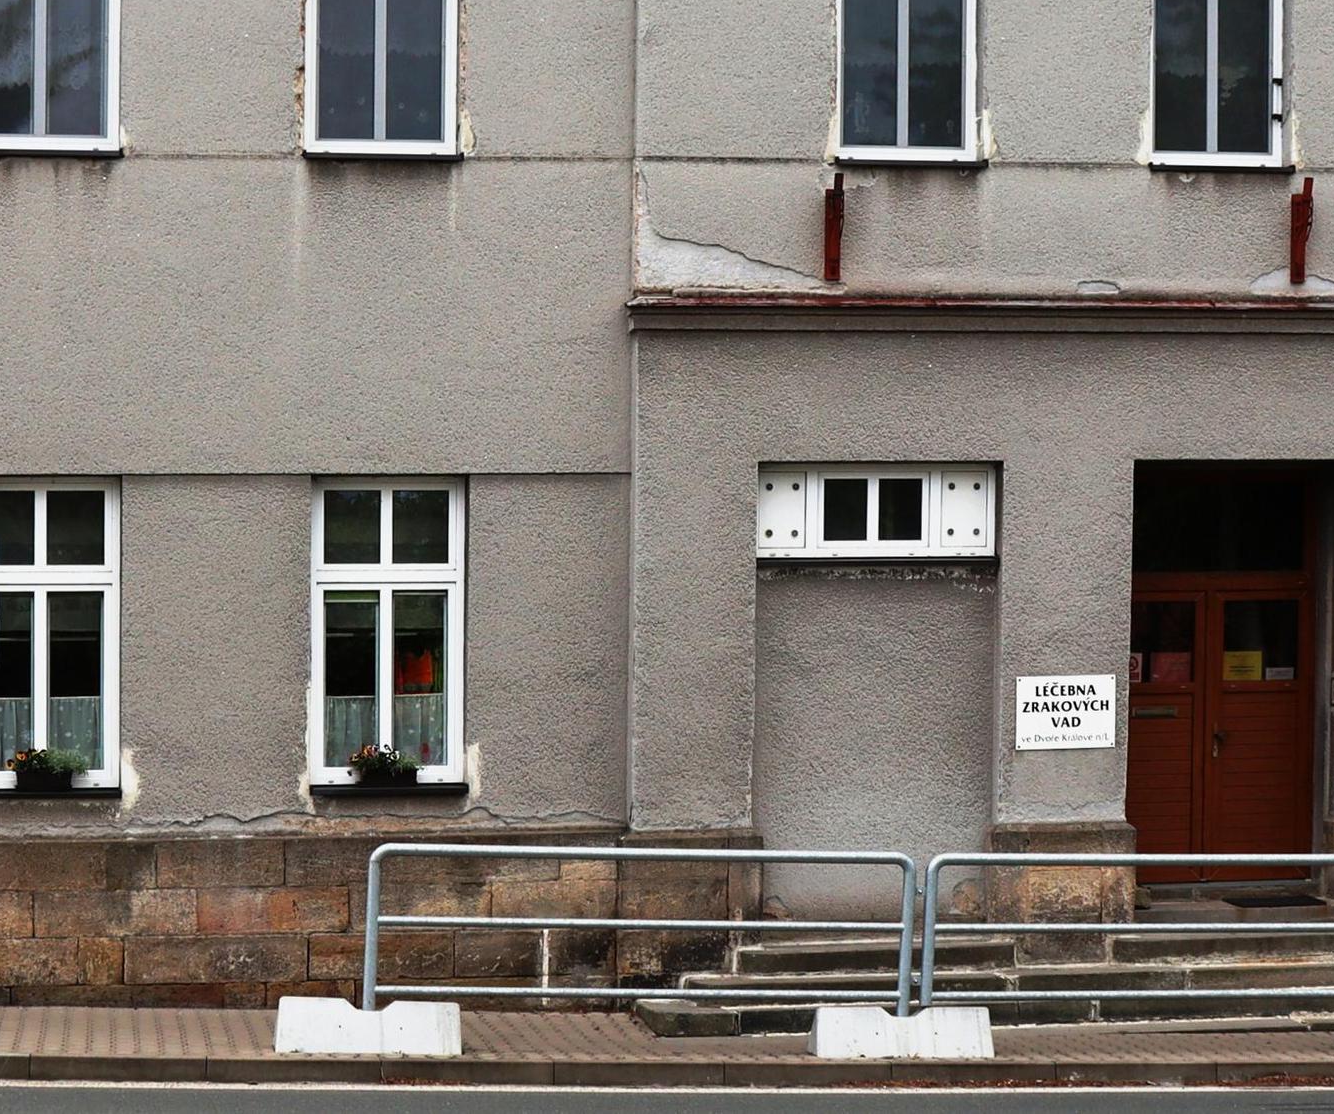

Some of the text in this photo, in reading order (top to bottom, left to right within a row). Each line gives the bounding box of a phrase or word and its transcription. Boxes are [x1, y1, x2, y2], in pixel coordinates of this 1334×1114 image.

[1035, 682, 1097, 697] LÉČEBNA
[1022, 697, 1109, 713] ZRAKOVÝCH
[1051, 716, 1082, 728] VAD
